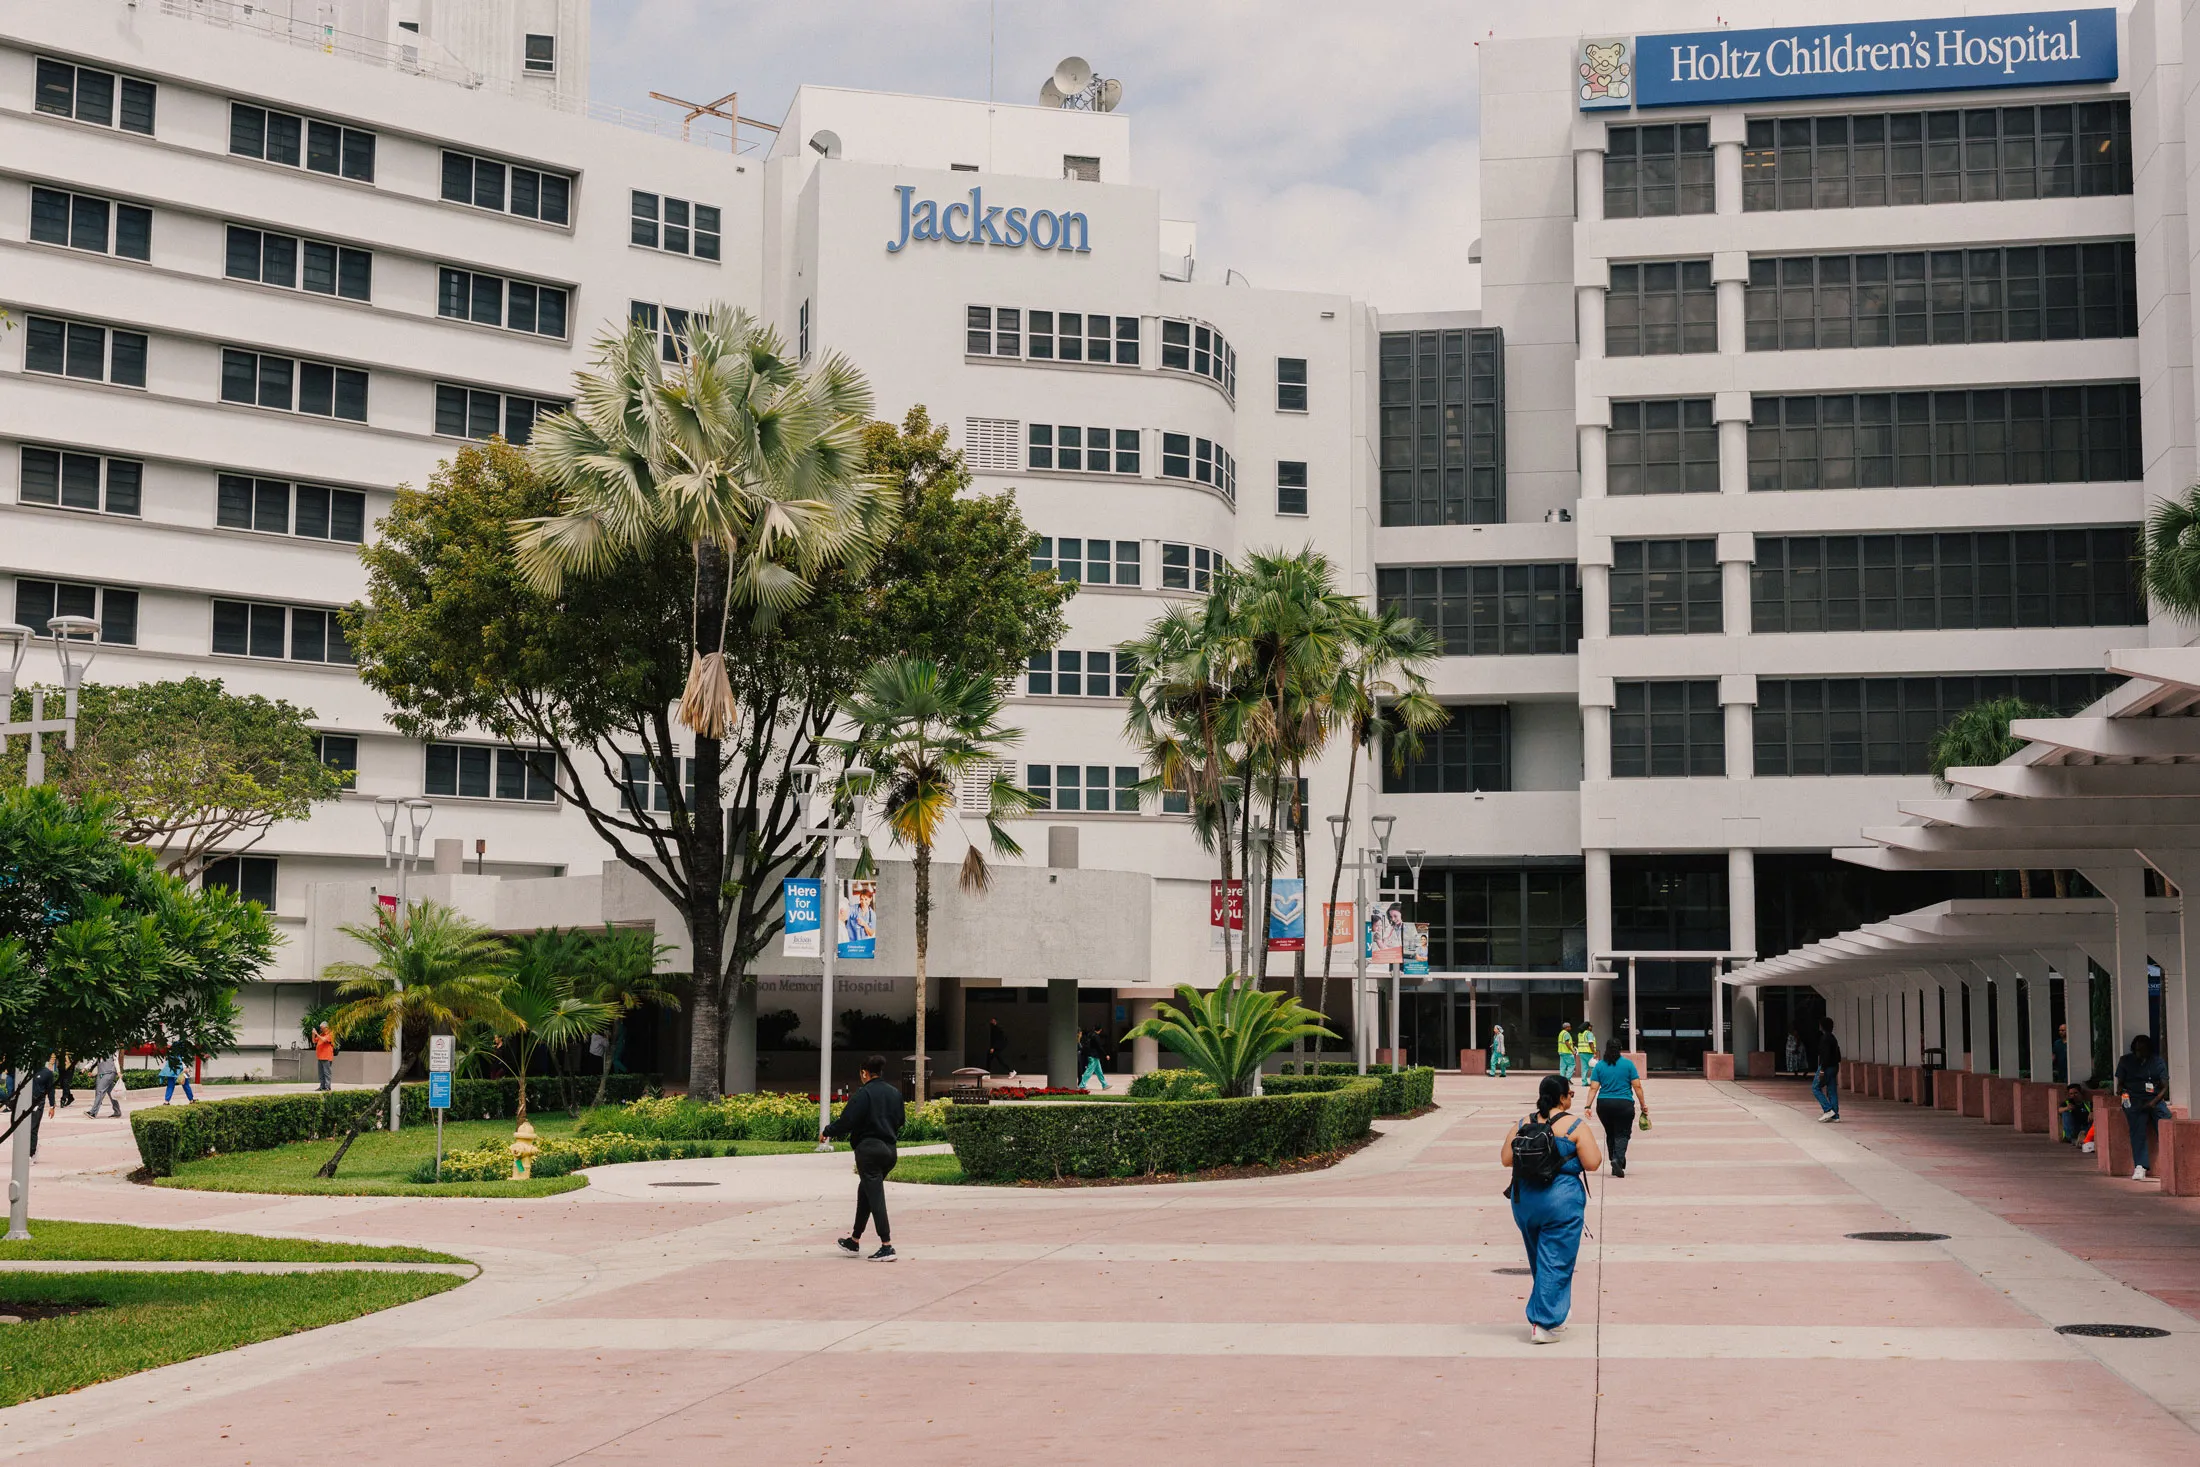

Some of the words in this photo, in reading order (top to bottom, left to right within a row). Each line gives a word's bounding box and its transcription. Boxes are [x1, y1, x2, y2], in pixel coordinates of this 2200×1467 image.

[1670, 40, 1761, 82] Holtz
[1766, 31, 1931, 77] Children's
[1935, 20, 2081, 74] Hospital
[886, 185, 1092, 252] Jackson
[787, 885, 817, 897] Here
[795, 898, 811, 908] for
[788, 910, 817, 923] you.
[779, 979, 836, 993] Memoril
[838, 979, 895, 996] Hospital
